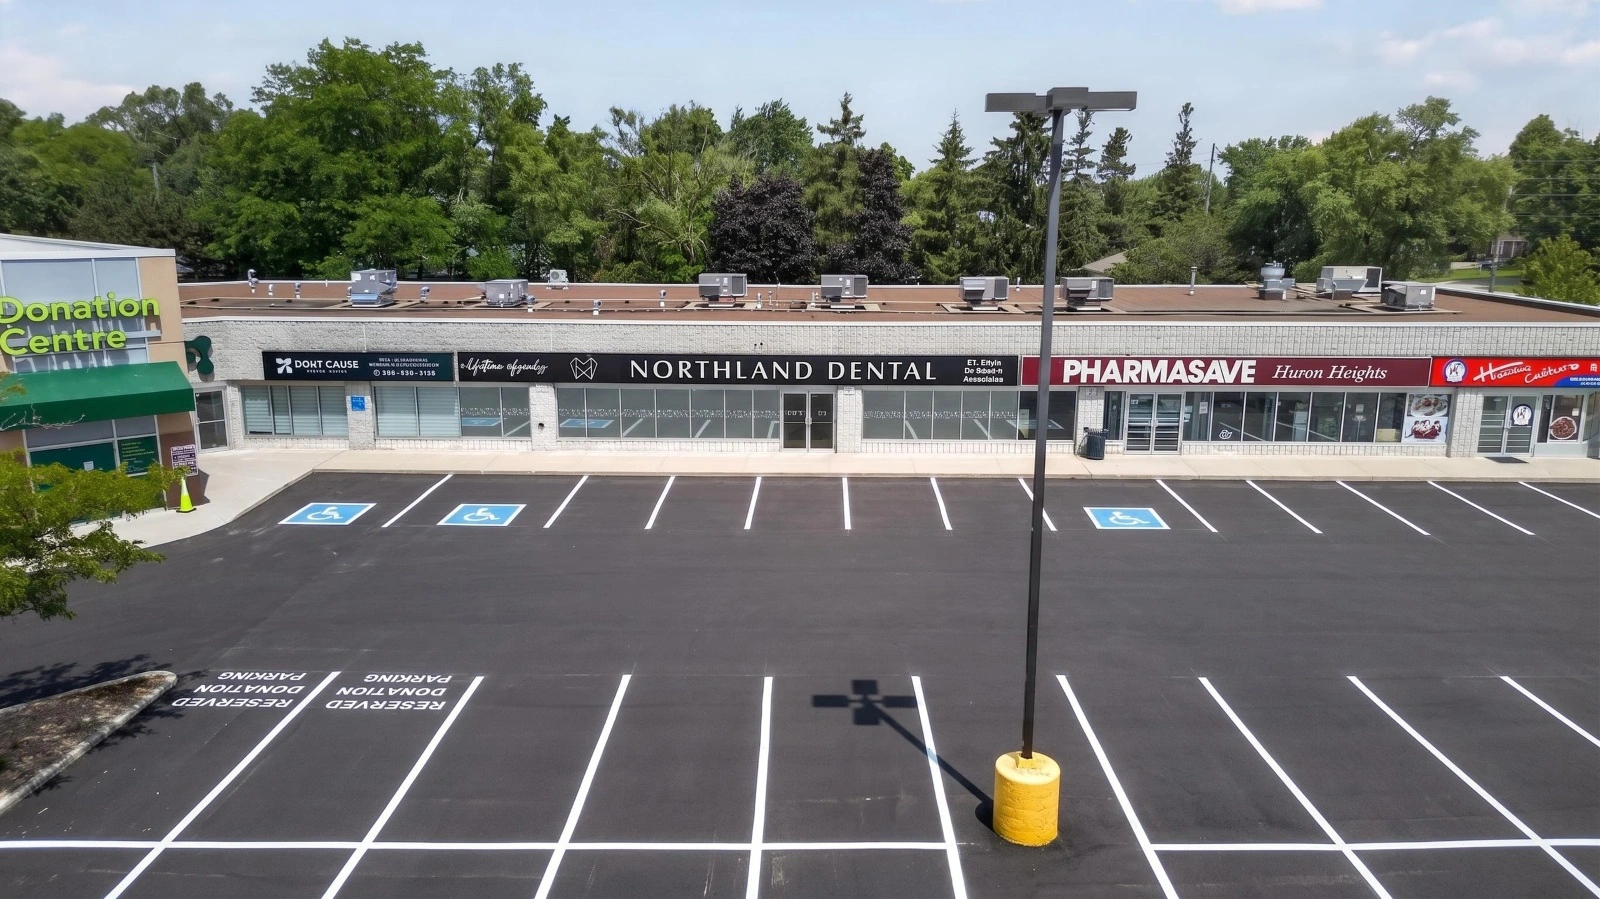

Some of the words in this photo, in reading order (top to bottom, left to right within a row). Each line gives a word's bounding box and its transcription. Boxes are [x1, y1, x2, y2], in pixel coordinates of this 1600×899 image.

[0, 292, 160, 324] Donation
[0, 327, 127, 355] Centre
[325, 360, 359, 369] CAUSE
[630, 360, 813, 380] NORTHLAND
[828, 361, 937, 380] DENTAL
[1063, 359, 1257, 384] PHARMASAVE
[1272, 365, 1324, 379] Huron
[1328, 365, 1388, 381] Heights
[217, 671, 307, 681] PARKING
[363, 674, 452, 683] PARKING
[194, 684, 305, 693] DONATION
[336, 687, 447, 696] DONATION
[172, 697, 293, 708] RESERVED
[325, 700, 446, 710] RESERVED
